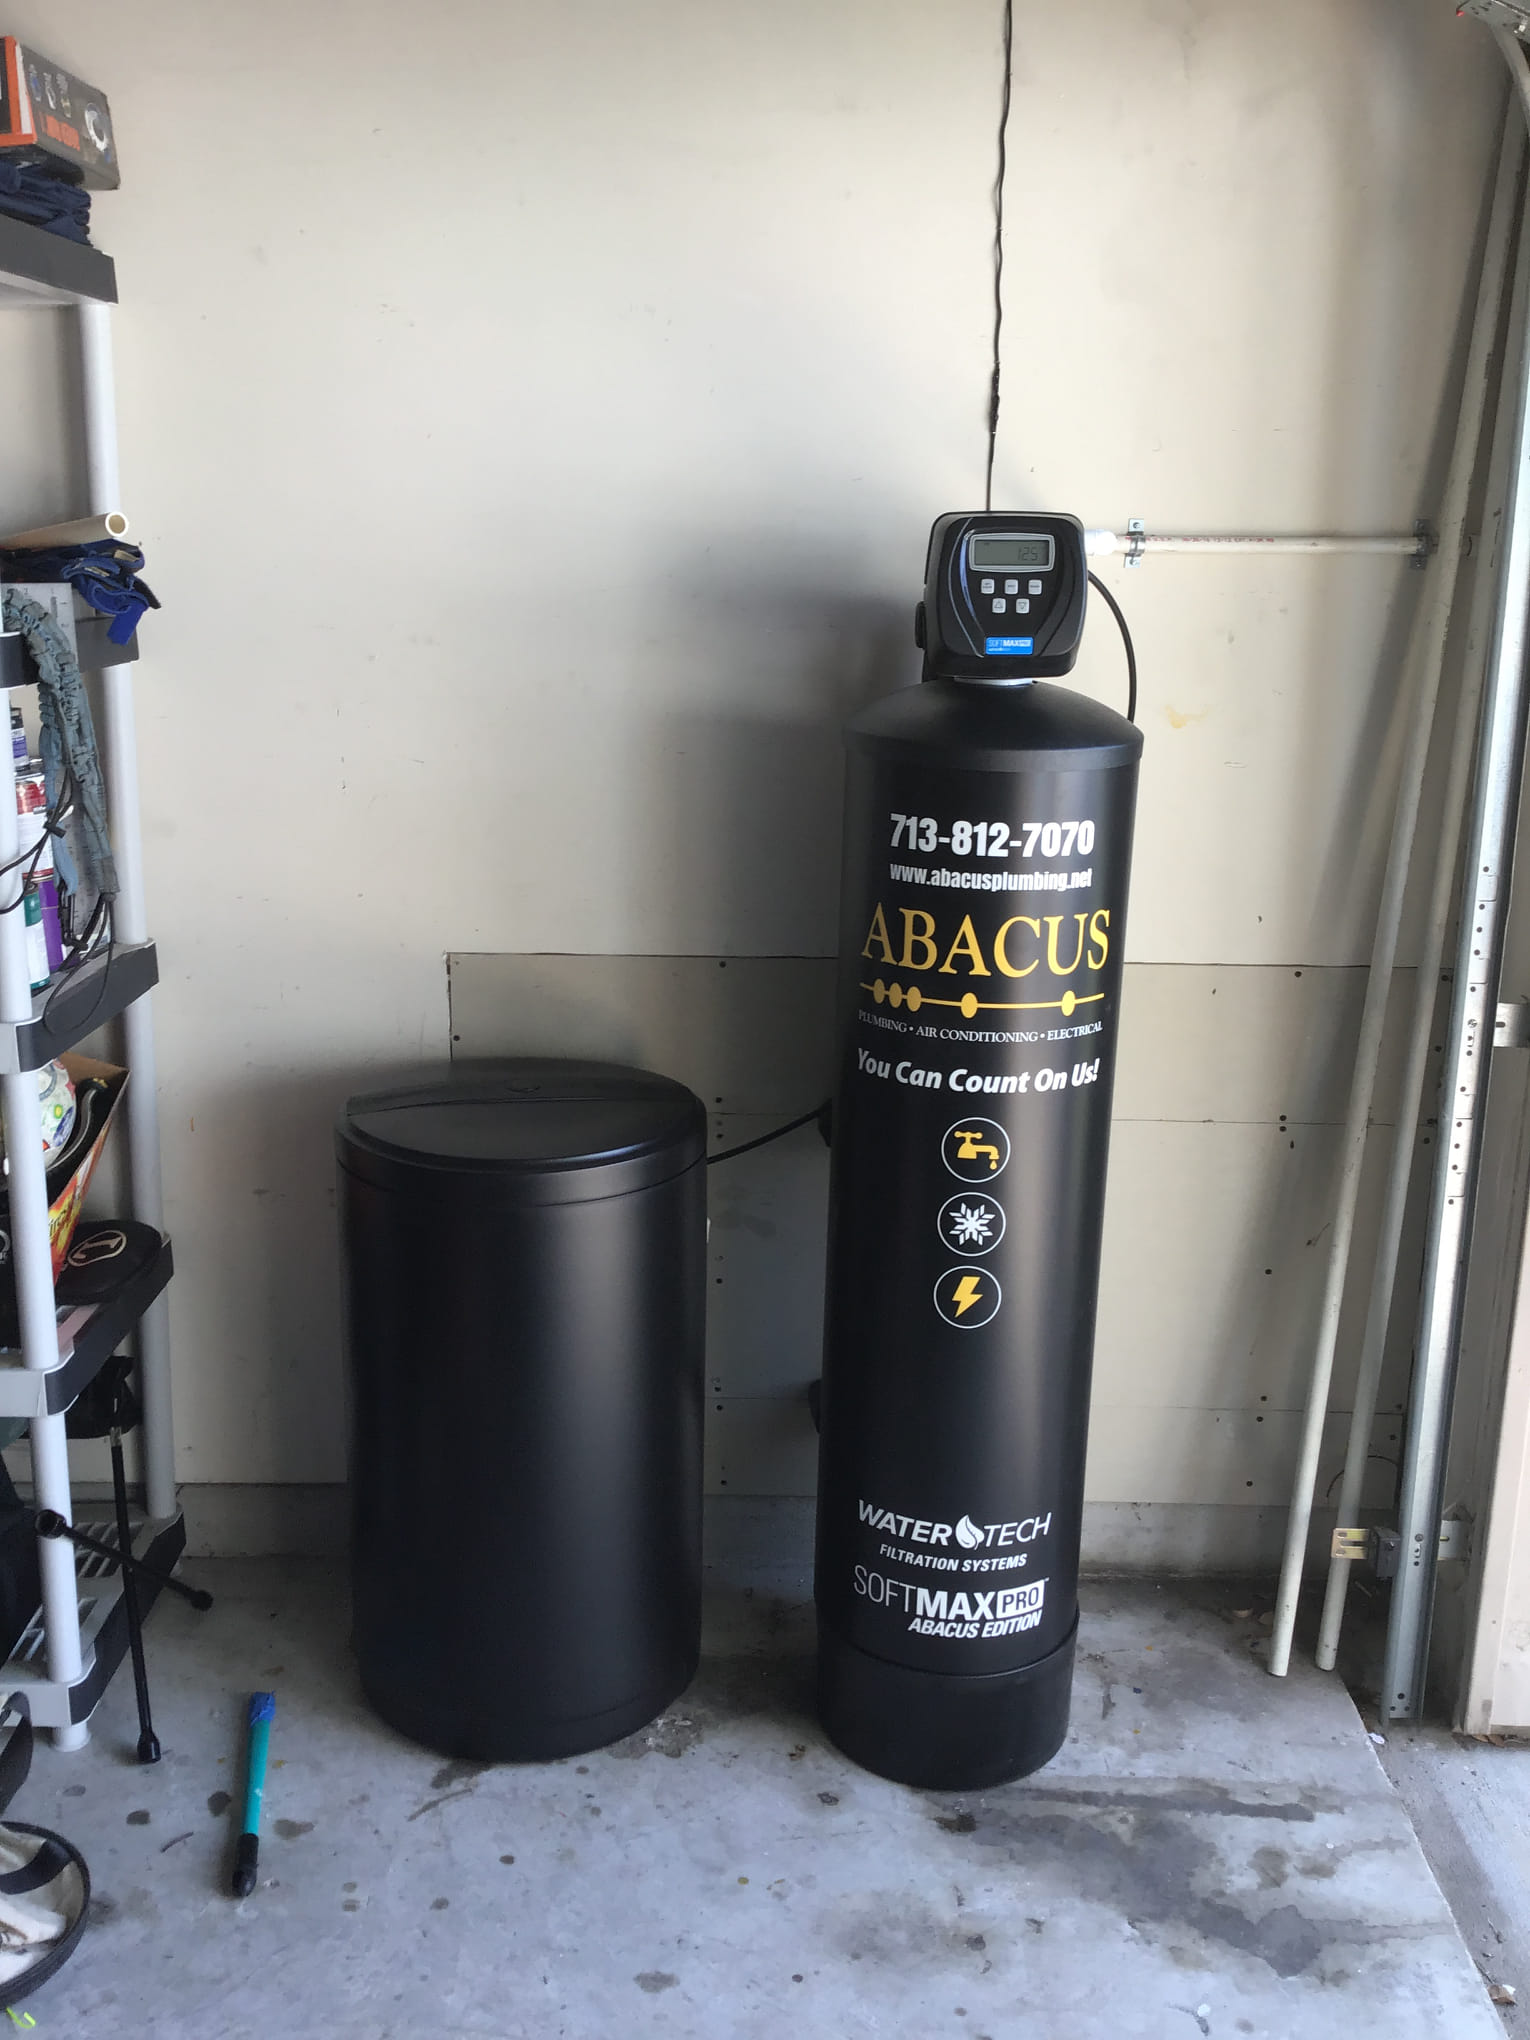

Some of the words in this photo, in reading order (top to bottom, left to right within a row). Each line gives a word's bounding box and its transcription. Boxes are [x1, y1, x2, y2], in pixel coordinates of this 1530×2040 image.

[890, 813, 1095, 858] 713-812-7070
[890, 863, 1092, 892] www.abacusplumbing.net
[861, 902, 1111, 978] ABACUS
[858, 1010, 907, 1033] PLUMBING
[916, 1026, 938, 1038] AIR
[940, 1028, 1038, 1042] CONDITIONING
[1047, 1020, 1103, 1041] ELECTRICAL
[858, 1048, 890, 1079] You
[896, 1062, 942, 1089] Can
[948, 1068, 1028, 1094] Count
[1034, 1068, 1067, 1092] On
[1071, 1058, 1100, 1082] Us!
[858, 1499, 952, 1547] WATER
[983, 1511, 1052, 1547] TECH
[880, 1543, 959, 1572] FILTRATION
[962, 1553, 1028, 1572] SYSTEMS
[908, 1617, 980, 1639] ABACUS
[982, 1609, 1042, 1638] EDITION
